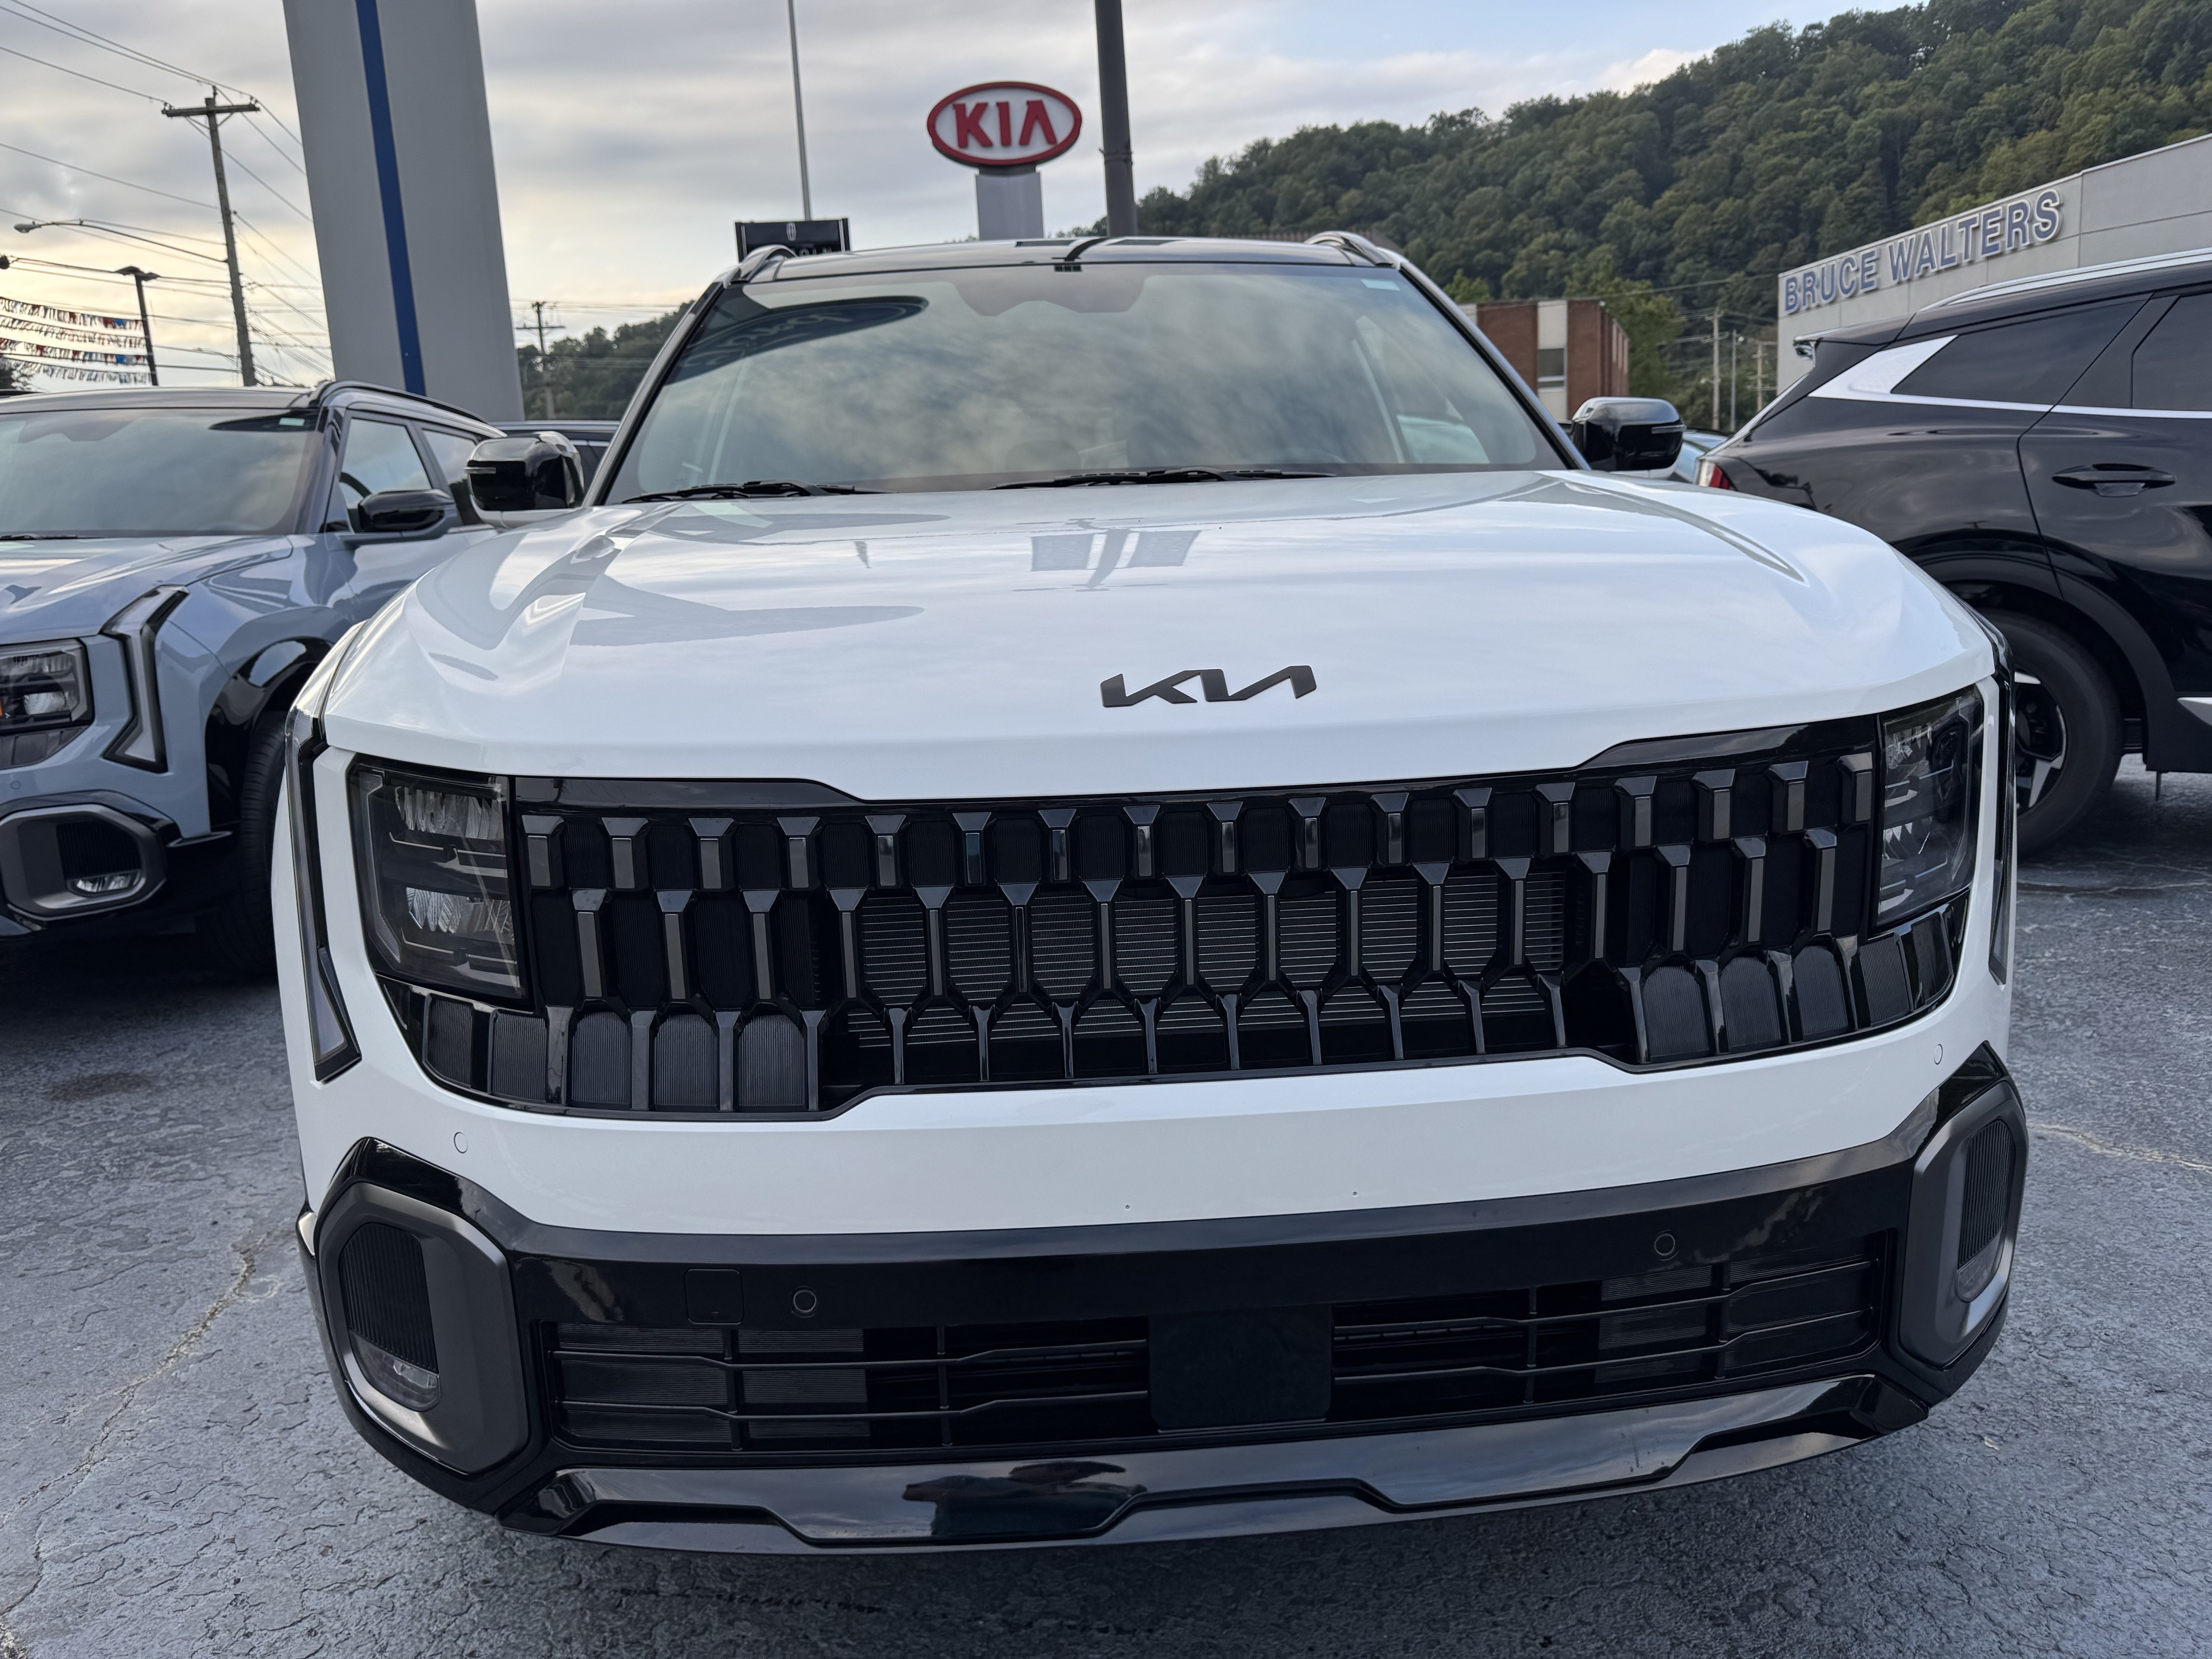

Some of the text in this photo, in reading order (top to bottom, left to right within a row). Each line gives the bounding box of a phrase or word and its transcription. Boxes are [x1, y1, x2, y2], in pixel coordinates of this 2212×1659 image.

[953, 100, 1057, 148] KIA
[1785, 189, 2063, 312] BRUCE WALTERS
